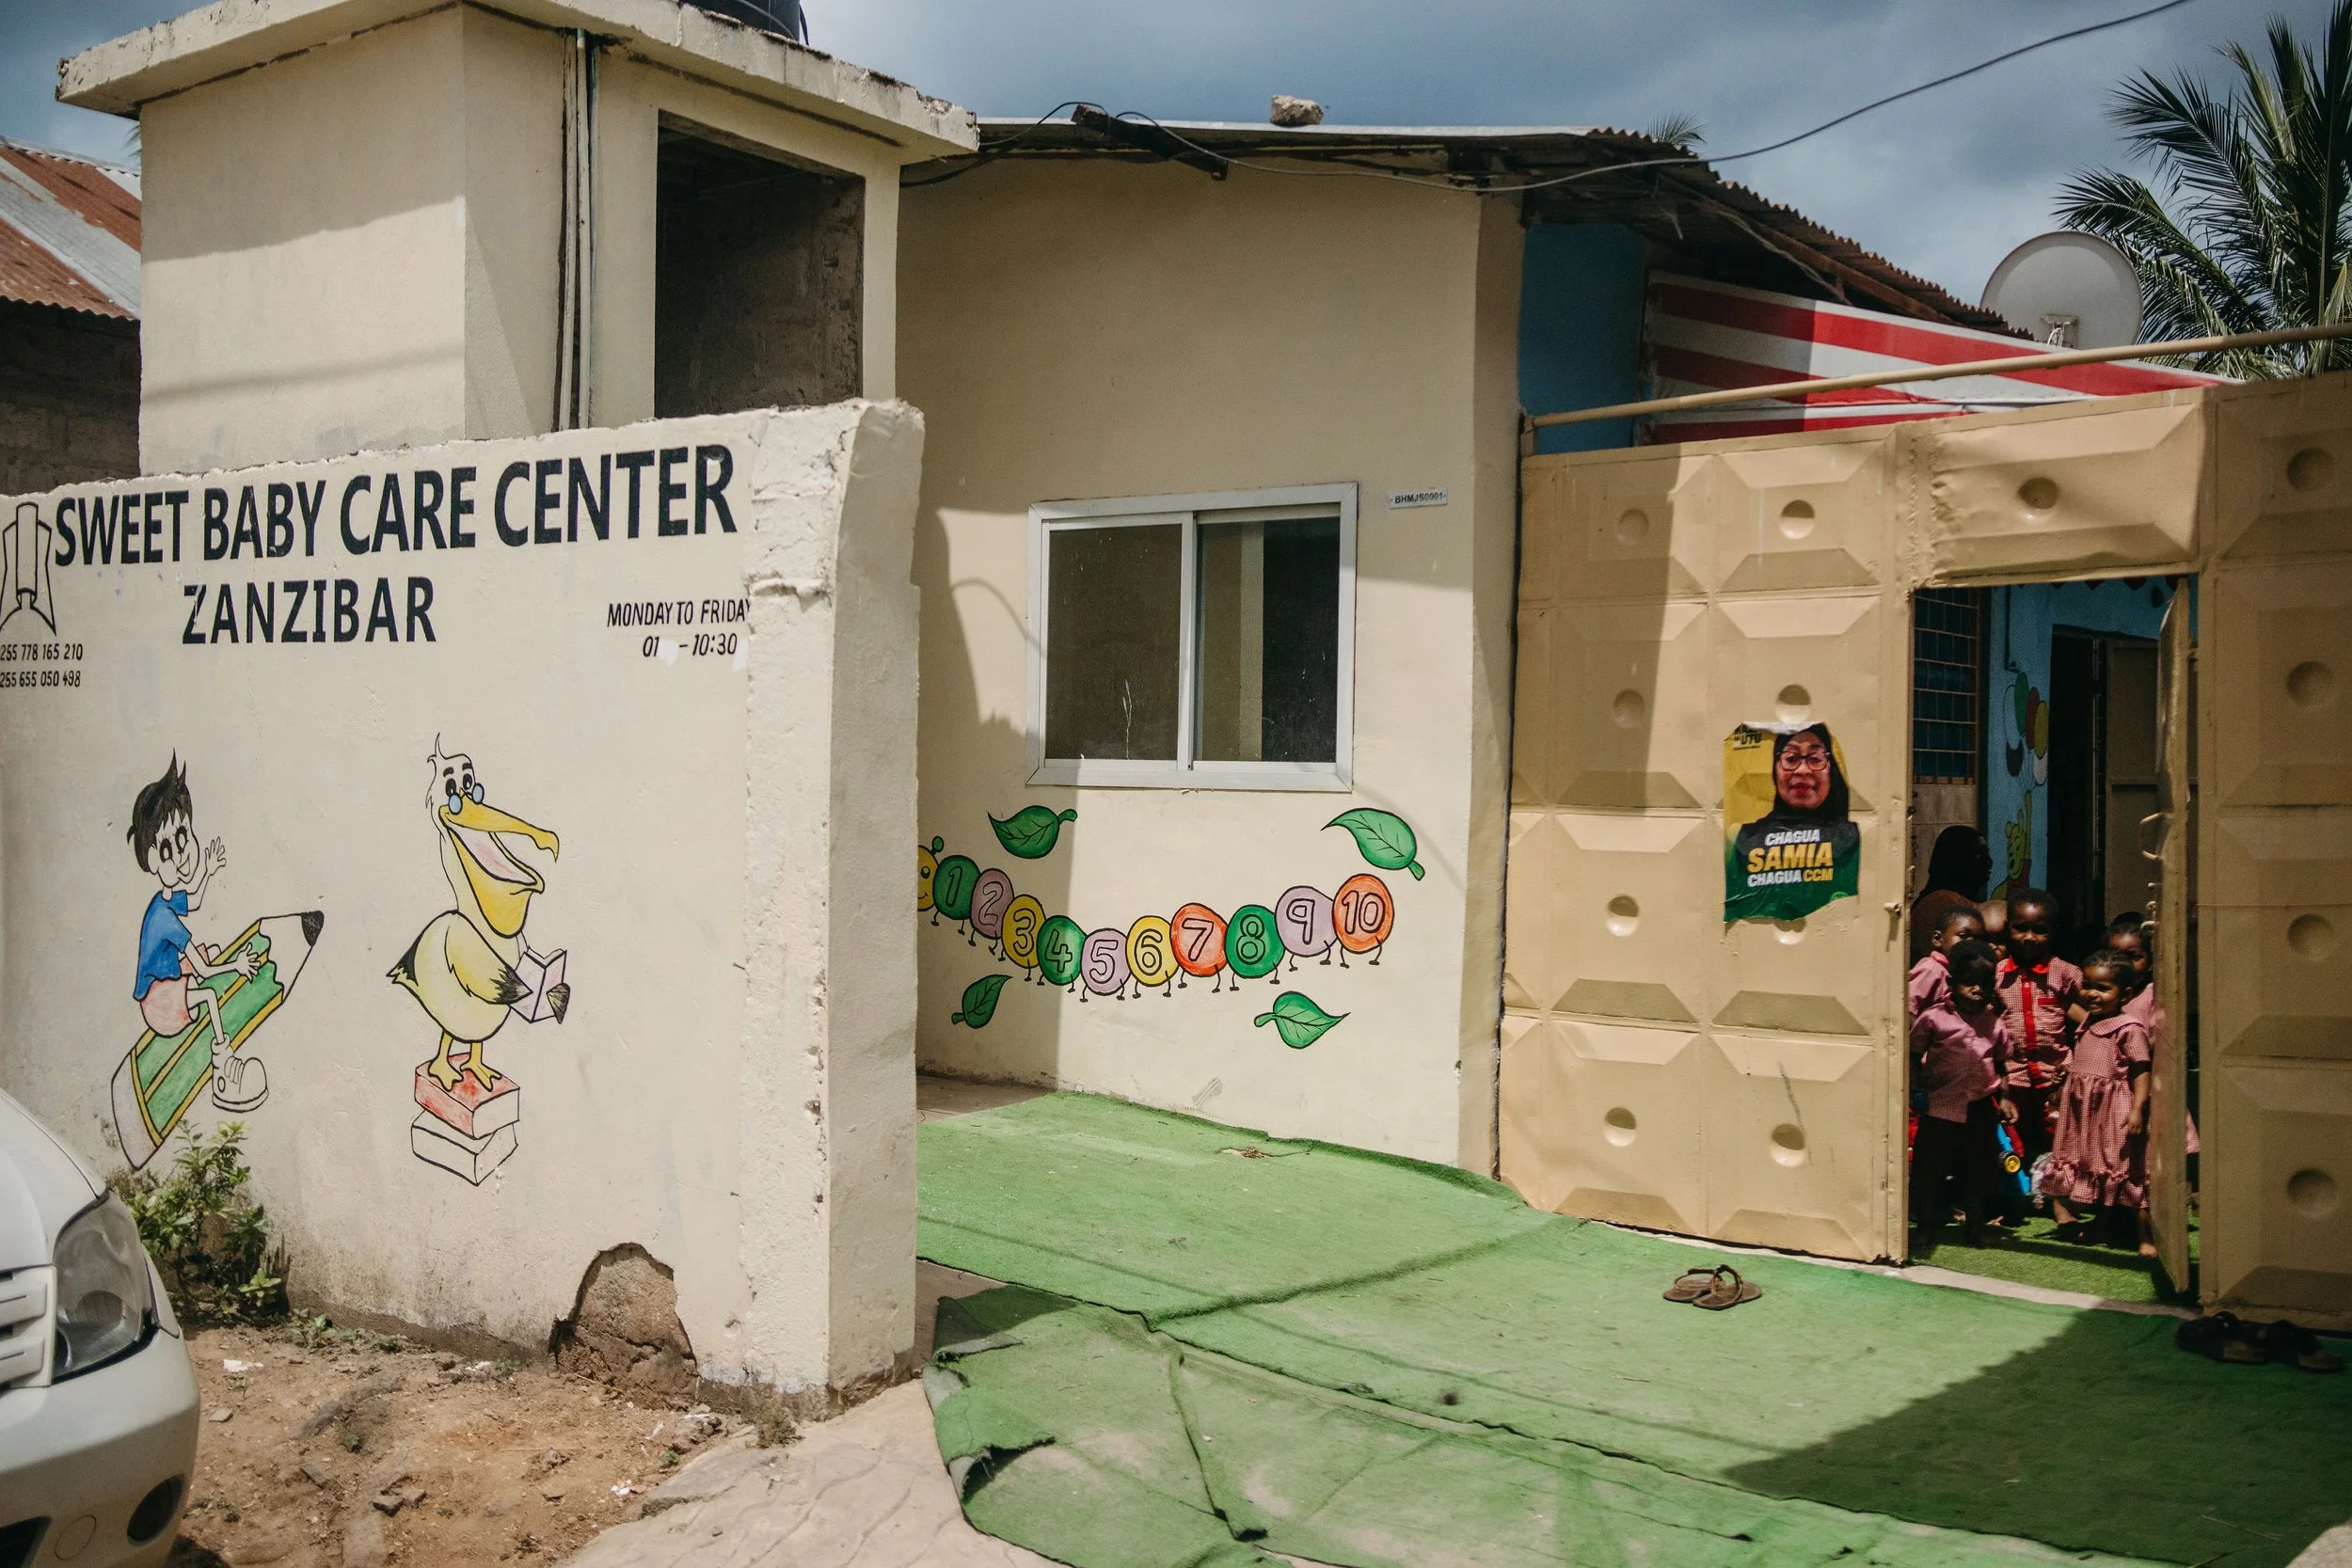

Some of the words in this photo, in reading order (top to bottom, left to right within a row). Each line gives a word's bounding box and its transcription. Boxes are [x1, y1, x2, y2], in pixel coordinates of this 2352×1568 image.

[56, 490, 188, 566] SWEET
[204, 480, 326, 561] BABY
[341, 467, 476, 555] CARE
[495, 444, 738, 547] CENTER
[183, 577, 437, 644] ZANZIBAR
[607, 601, 674, 627] MONDAY
[676, 600, 694, 626] TO
[0, 643, 18, 661] 255
[21, 643, 39, 661] 778
[42, 642, 60, 660] 165
[63, 642, 83, 661] 210
[0, 671, 17, 689] 255
[19, 671, 38, 688] 655
[40, 670, 60, 687] 050
[62, 670, 81, 688] 498
[1765, 829, 1820, 846] CHAGUA
[1747, 842, 1833, 873] SAMIA
[1747, 869, 1803, 887] CHAGUA
[1804, 867, 1834, 882] CCM
[946, 865, 962, 908] 1
[978, 881, 1004, 927] 2
[1013, 908, 1037, 957] 3
[1044, 928, 1073, 973] 4
[1089, 939, 1119, 984] 5
[1134, 928, 1163, 975] 6
[1182, 917, 1214, 961] 7
[1236, 914, 1265, 965] 8
[1286, 897, 1315, 944] 9
[1342, 890, 1386, 934] 10
